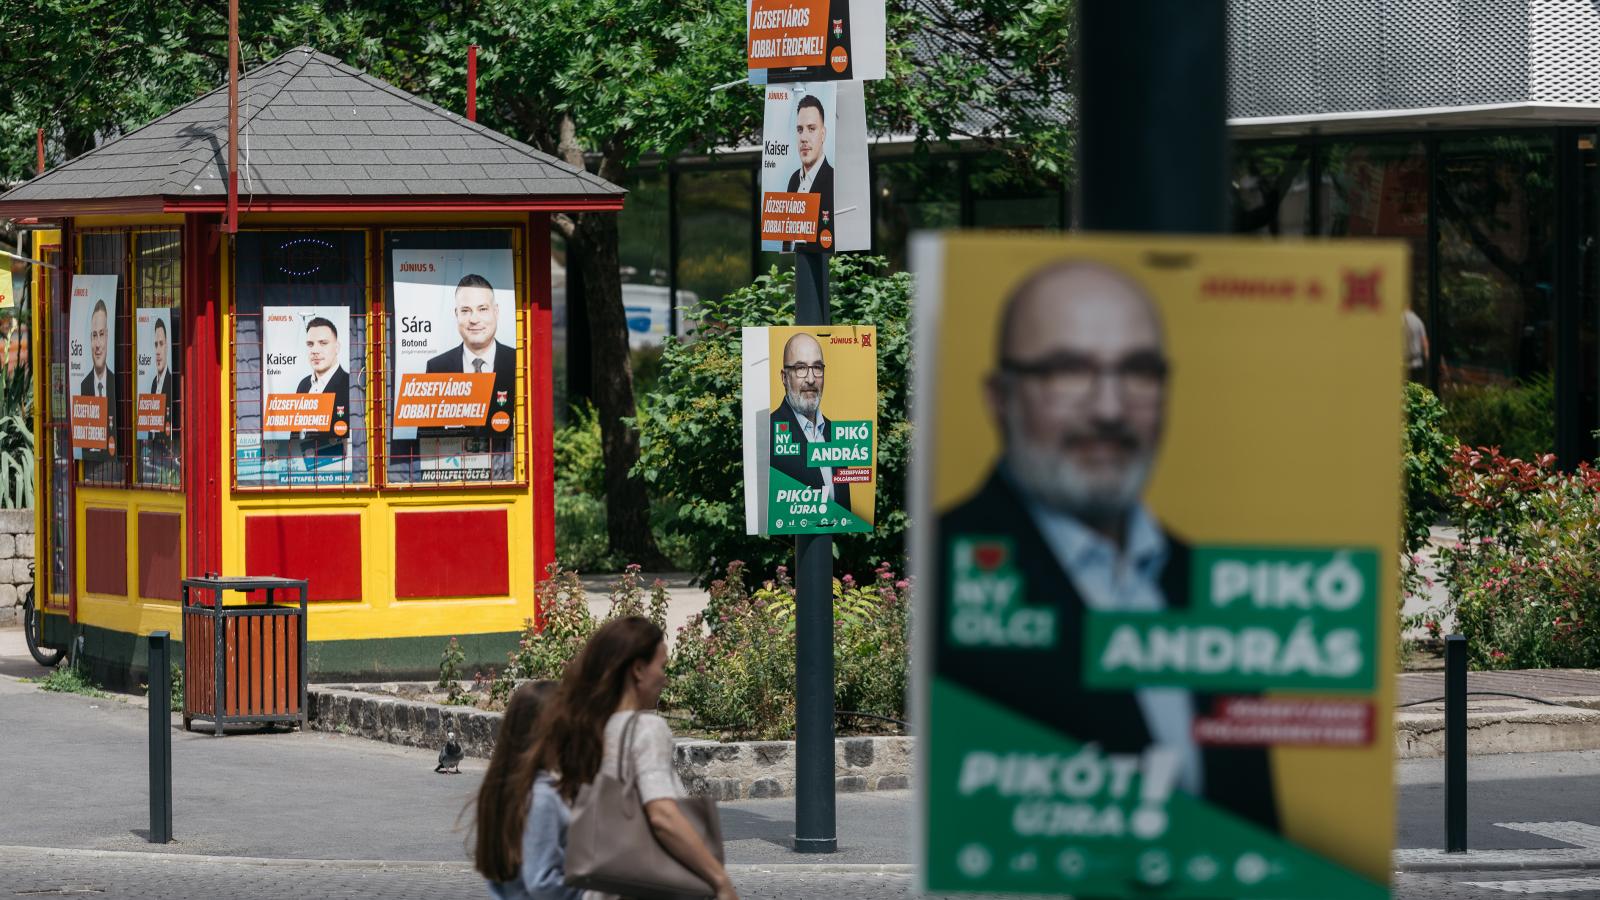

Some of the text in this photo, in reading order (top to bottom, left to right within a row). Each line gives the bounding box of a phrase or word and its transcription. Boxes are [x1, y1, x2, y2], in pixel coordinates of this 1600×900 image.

[752, 4, 810, 30] JÓZSEFVÁROS
[750, 33, 824, 58] JOBBAT ÉRDEMEL!
[764, 140, 789, 156] Kaiser
[764, 196, 806, 214] JÓZSEFVÁROS
[763, 217, 816, 234] JOBBAT ÉRDEMEL!
[400, 262, 436, 273] JÚNIUS 9.
[401, 316, 432, 333] Sára
[70, 339, 83, 356] Sára
[401, 338, 428, 347] Botond
[830, 336, 852, 344] JÚNIUS
[266, 353, 297, 365] Kaiser
[402, 378, 473, 397] JÓZSEFVÁROS
[268, 396, 319, 411] JÓZSEFVÁROS
[397, 400, 486, 419] JOBBAT ÉRDEMEL!
[265, 413, 330, 426] JOBBAT ÉRDEMEL!
[775, 424, 779, 433] I
[835, 423, 869, 440] PIKÓ
[775, 434, 791, 444] NY
[243, 450, 257, 458] ITT
[775, 444, 799, 454] OLC!
[811, 444, 869, 462] ANDRÁS
[789, 503, 817, 514] ÚJRA
[1211, 551, 1365, 611] PIKÓ
[1101, 617, 1365, 678] ANDRÁS
